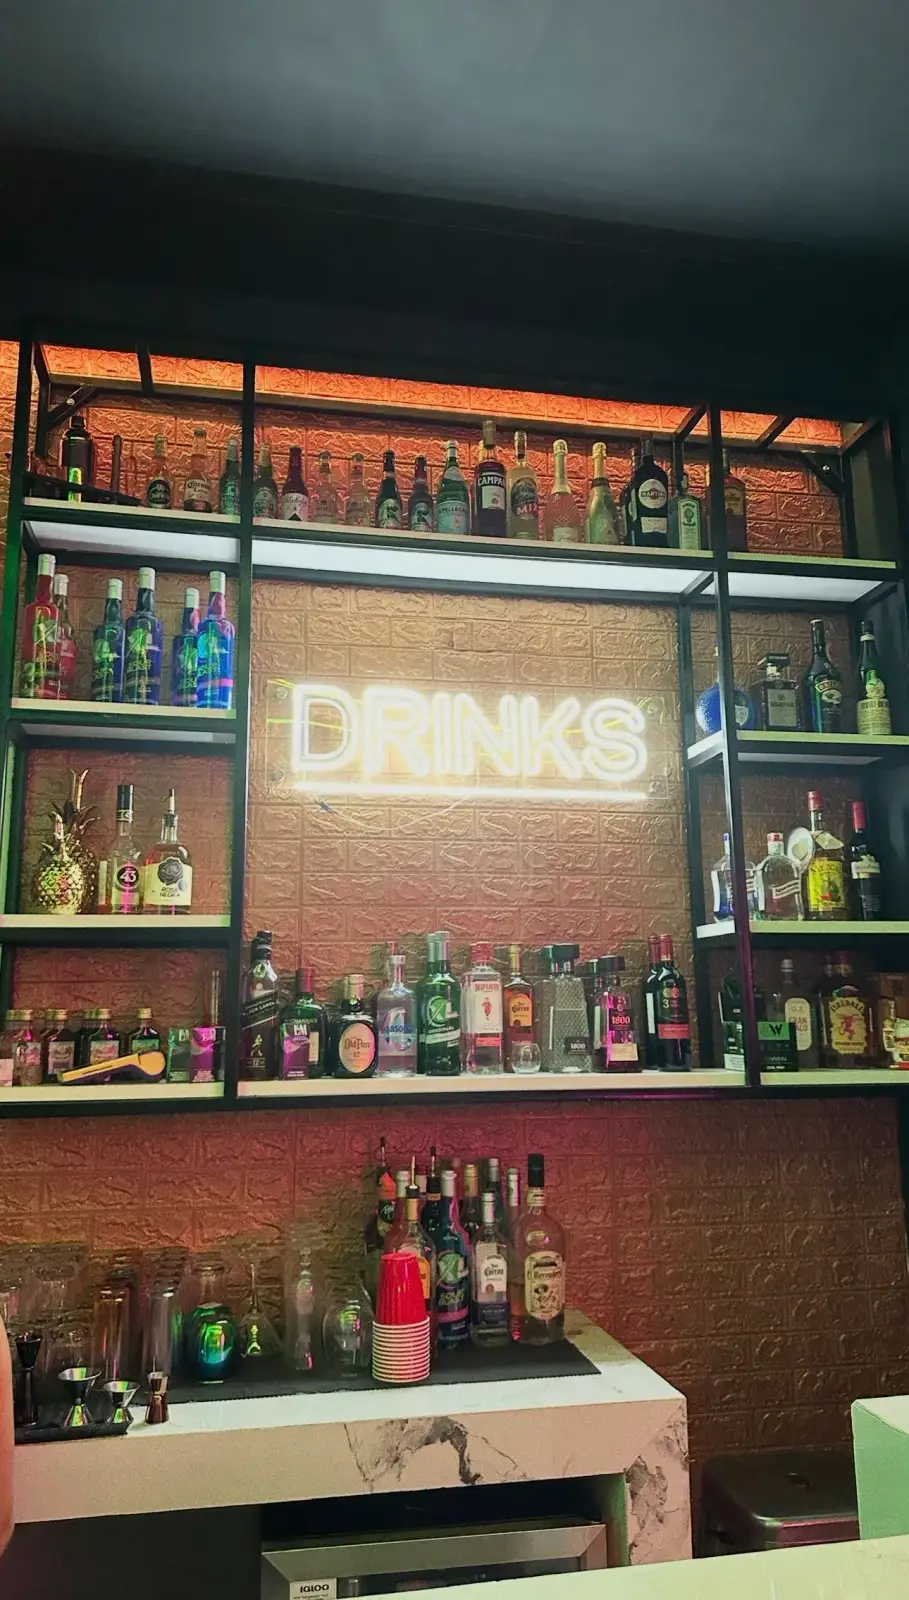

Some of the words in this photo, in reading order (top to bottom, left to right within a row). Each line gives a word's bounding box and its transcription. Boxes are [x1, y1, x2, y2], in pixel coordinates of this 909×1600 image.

[187, 480, 211, 491] Corona
[478, 475, 505, 487] CAMPA
[293, 684, 647, 781] DRINKS
[120, 870, 137, 882] 43
[611, 1016, 631, 1024] 1800
[300, 1583, 330, 1593] IGLOO
